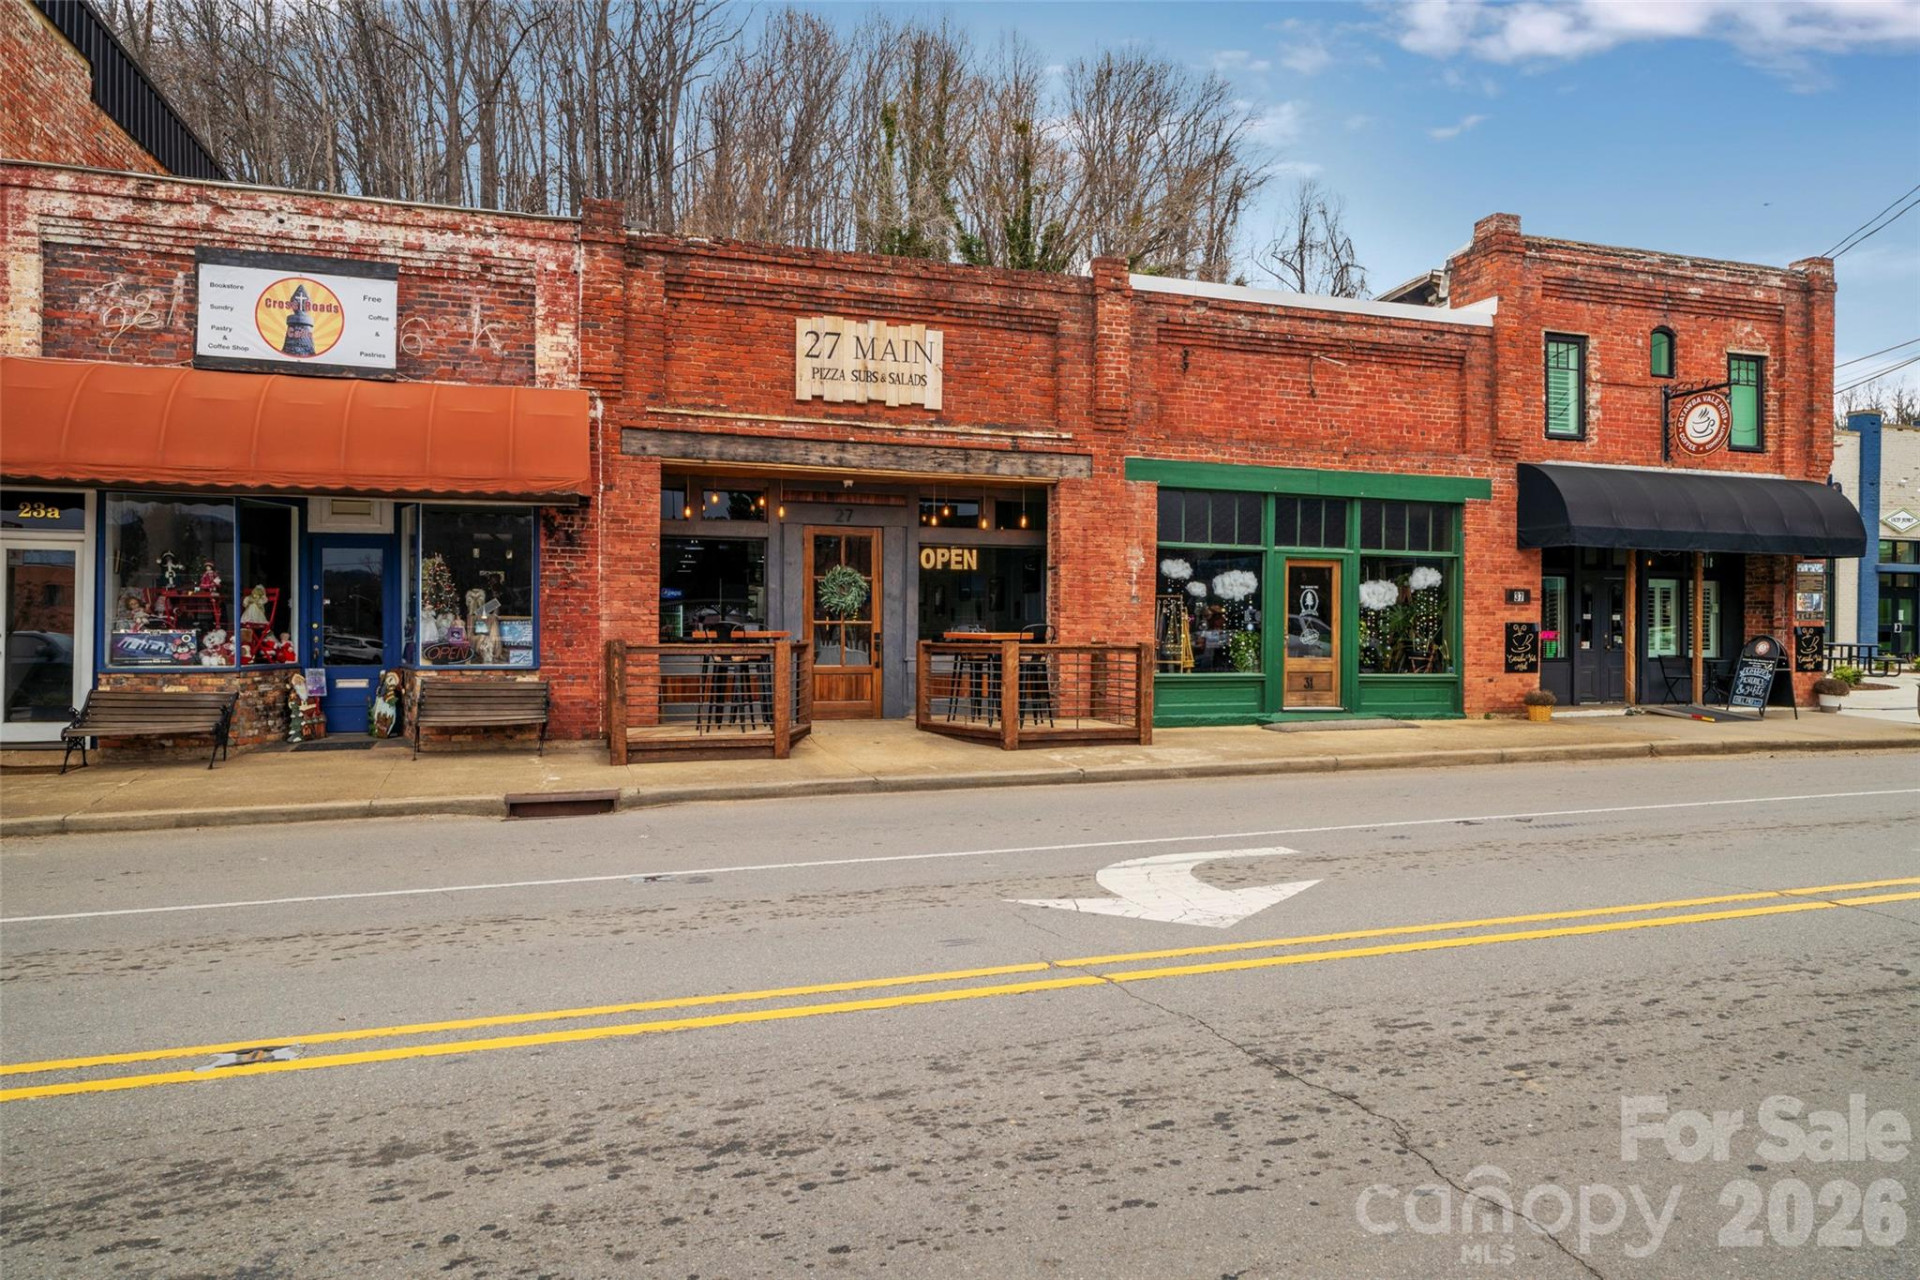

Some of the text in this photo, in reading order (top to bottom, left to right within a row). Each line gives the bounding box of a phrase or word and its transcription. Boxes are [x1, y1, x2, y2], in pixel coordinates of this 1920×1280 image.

[209, 281, 245, 291] Bookstore
[362, 294, 382, 303] Free
[209, 303, 234, 312] Sundry
[264, 297, 339, 314] Cross Roads
[367, 314, 390, 322] Coffee
[210, 324, 233, 333] Pastry
[207, 342, 250, 353] Coffee Shop
[804, 330, 935, 364] 27 MAIN
[359, 351, 386, 359] Pastries
[811, 366, 928, 387] PIZZA SUBS & SALADS
[1703, 395, 1719, 406] VALE
[18, 502, 61, 519] 23a
[834, 508, 854, 523] 27
[920, 547, 978, 571] OPEN
[427, 645, 470, 660] OPEN
[1303, 676, 1314, 690] 31
